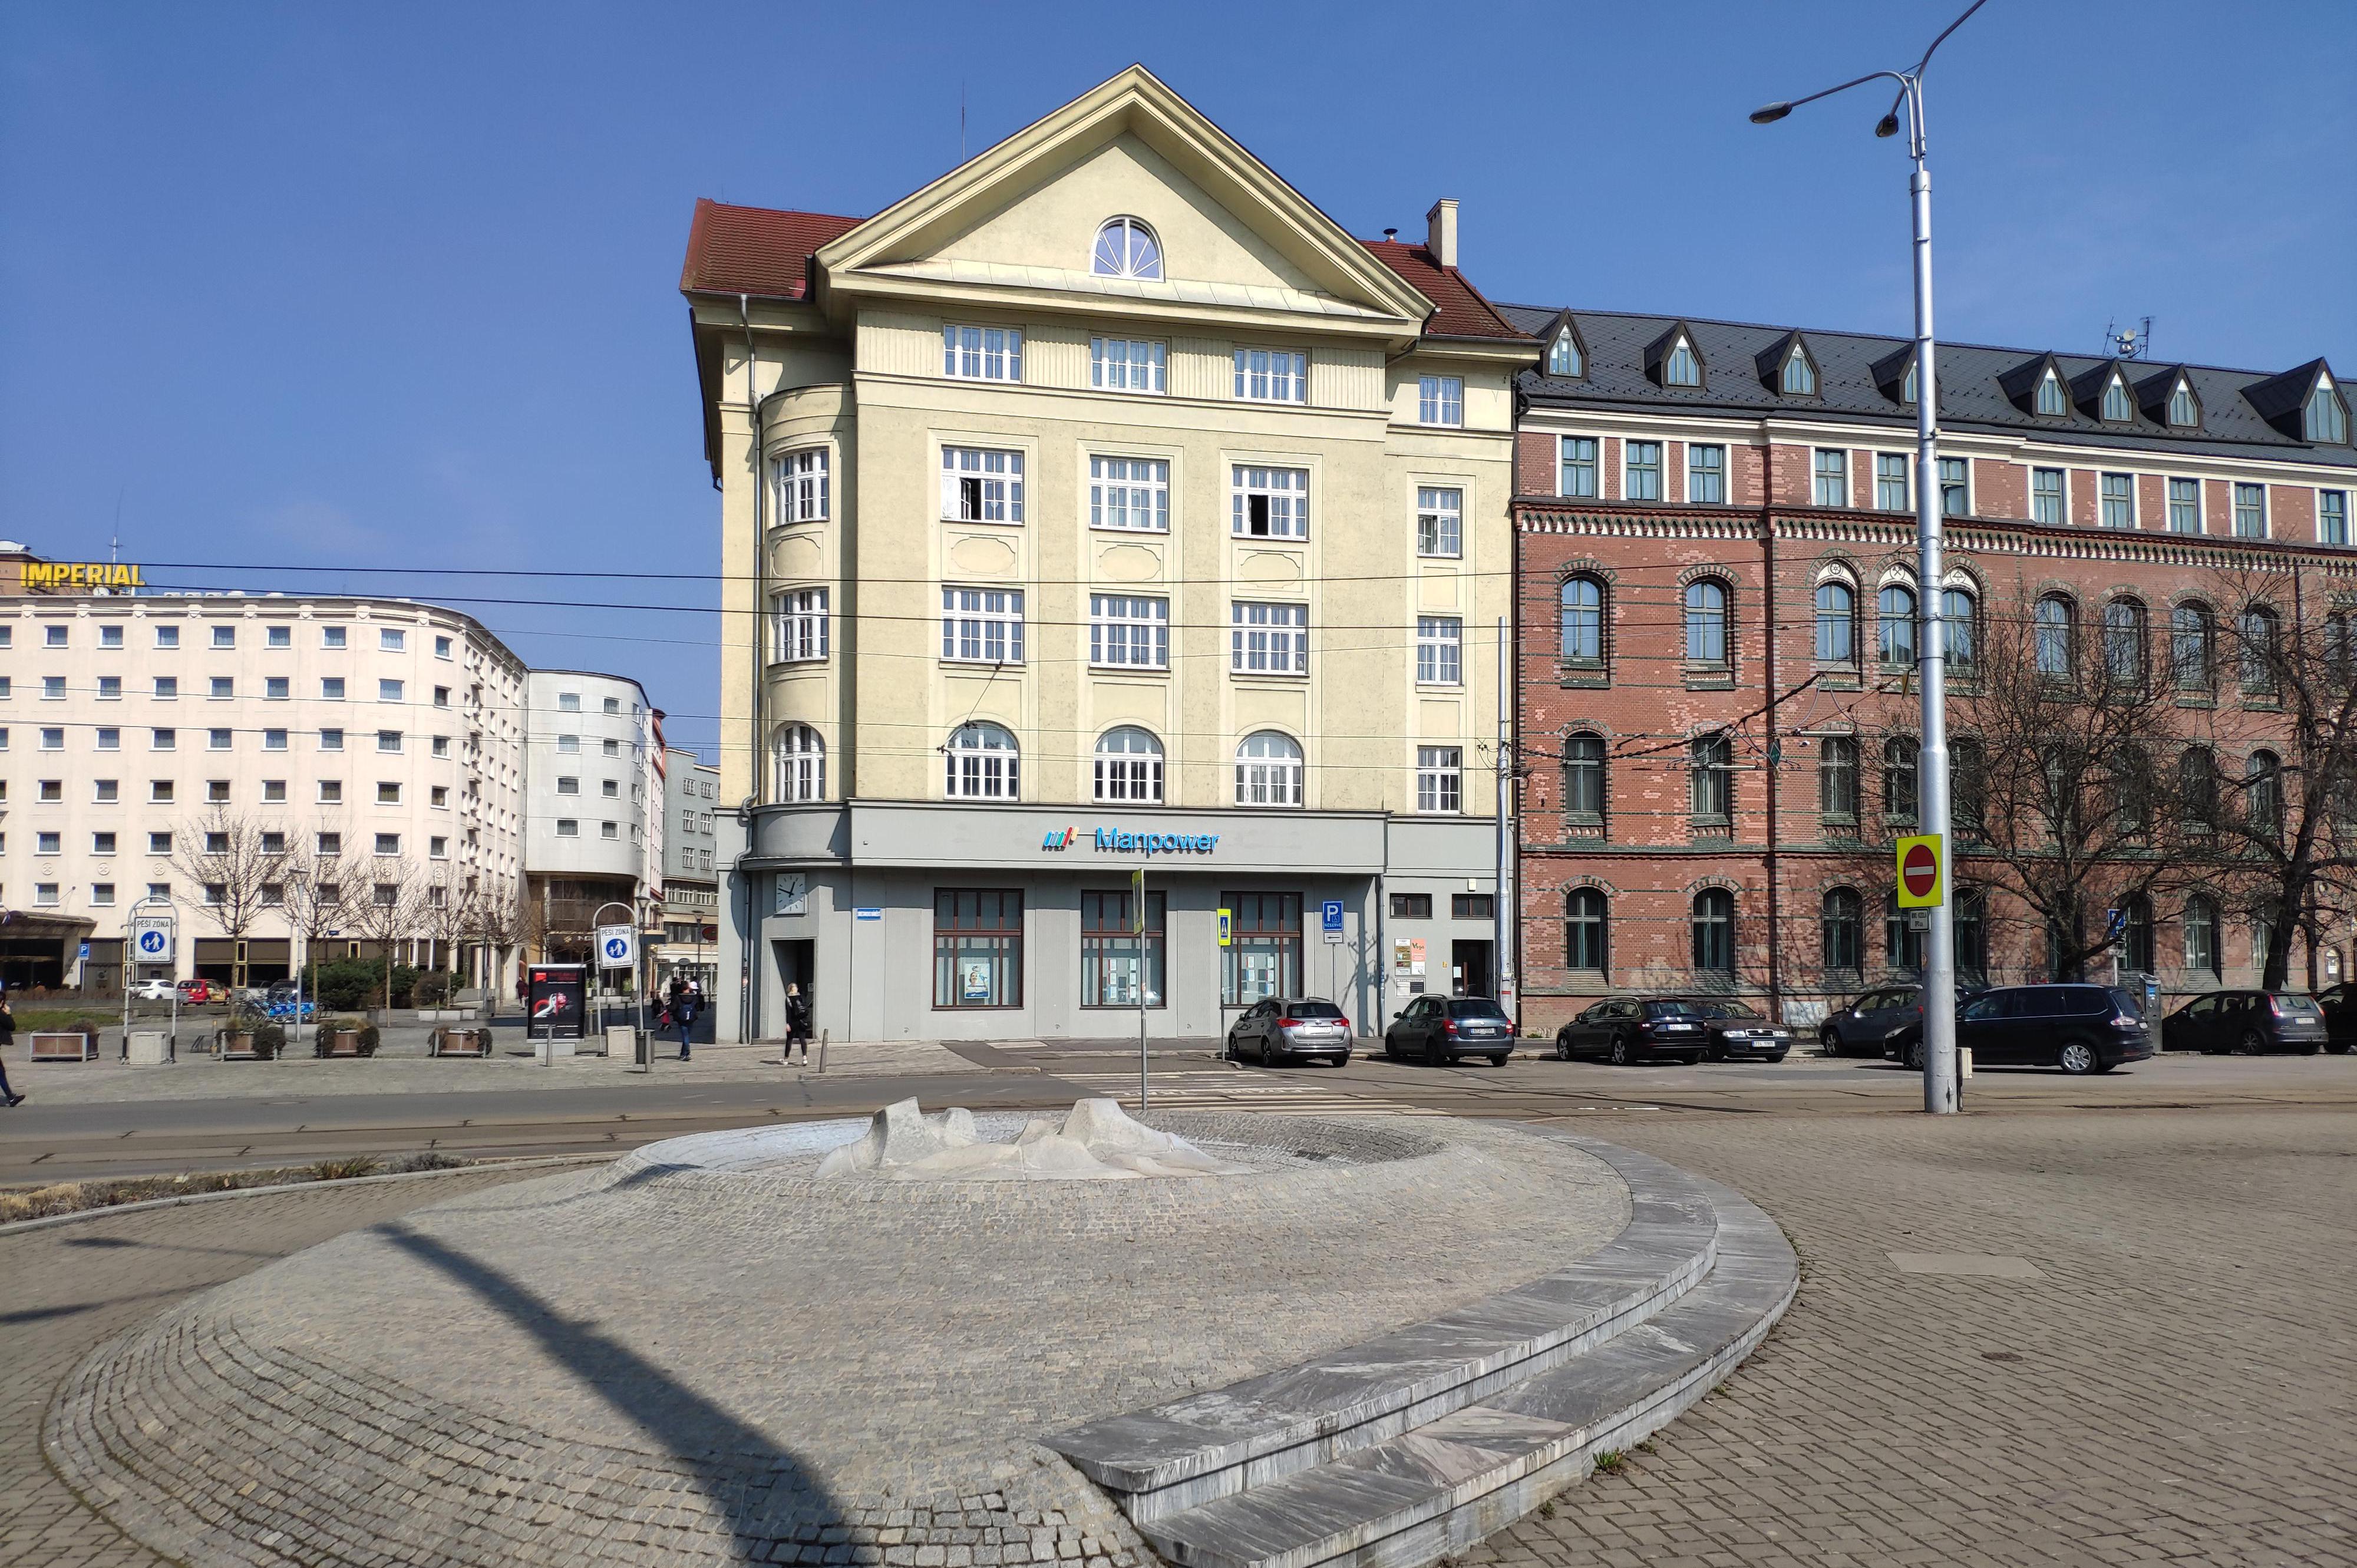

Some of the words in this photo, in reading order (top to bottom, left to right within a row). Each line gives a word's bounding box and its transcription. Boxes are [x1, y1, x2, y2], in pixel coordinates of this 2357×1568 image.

[21, 563, 146, 587] IMPERIAL
[1097, 826, 1220, 854] Manpower
[137, 919, 151, 927] PĚŠÍ
[153, 919, 169, 927] ZÓNA
[1327, 905, 1338, 922] P
